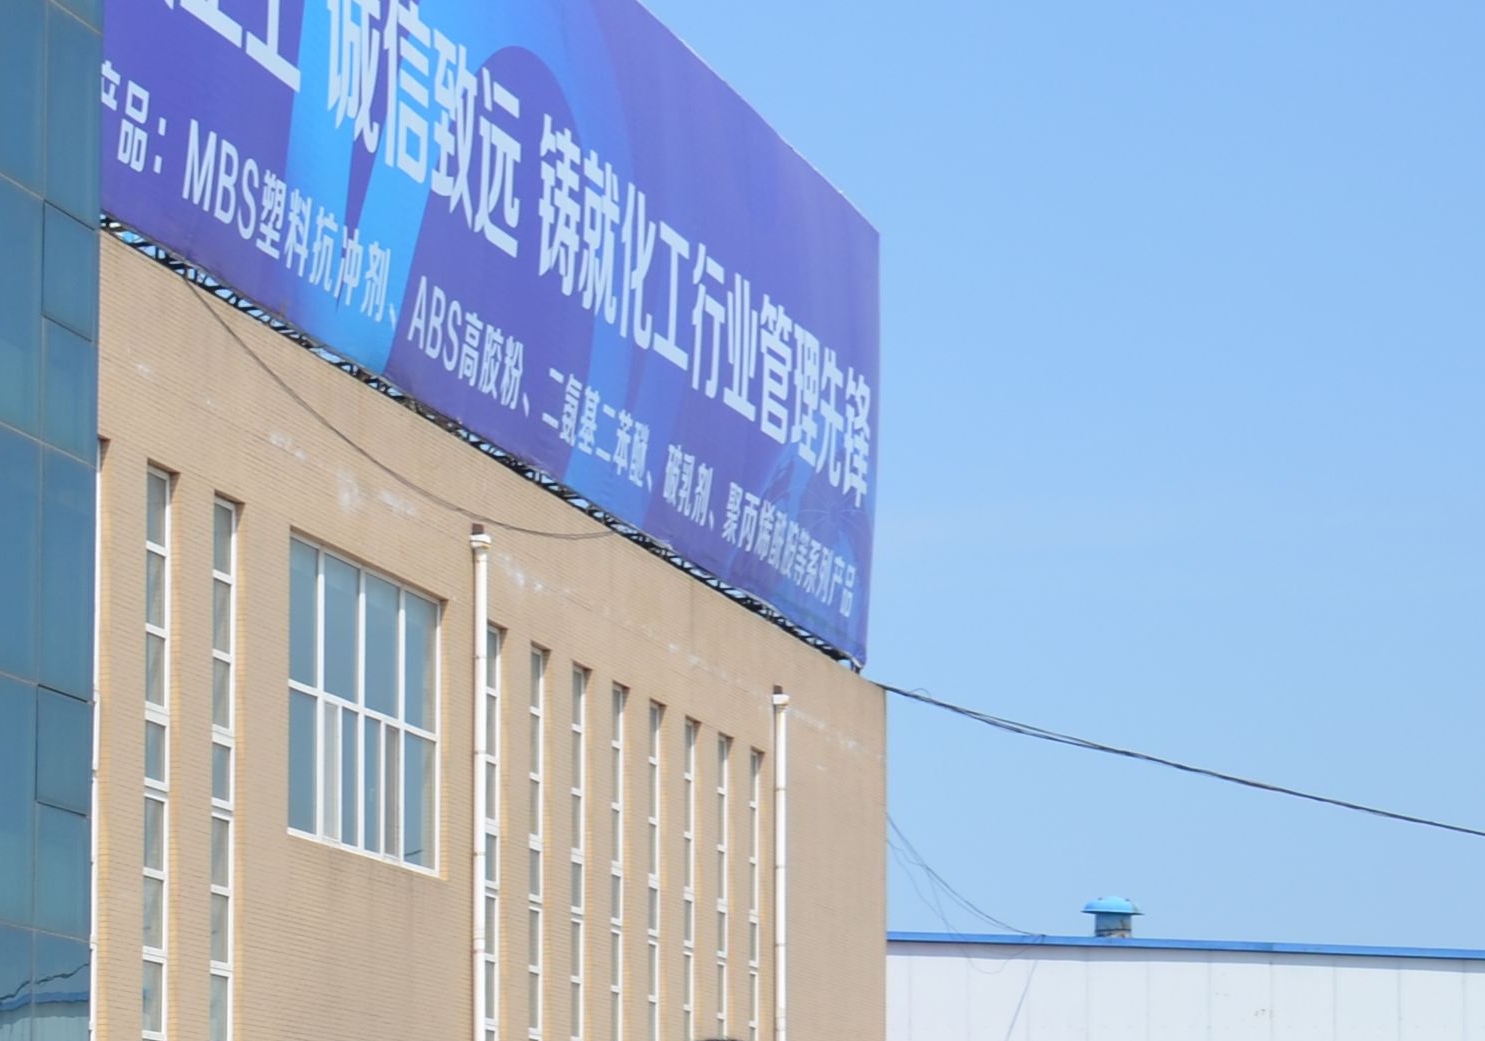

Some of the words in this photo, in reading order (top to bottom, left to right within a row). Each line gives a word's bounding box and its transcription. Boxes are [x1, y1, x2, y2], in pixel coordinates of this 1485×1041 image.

[539, 113, 871, 508] 铸就化工行业管理先锋
